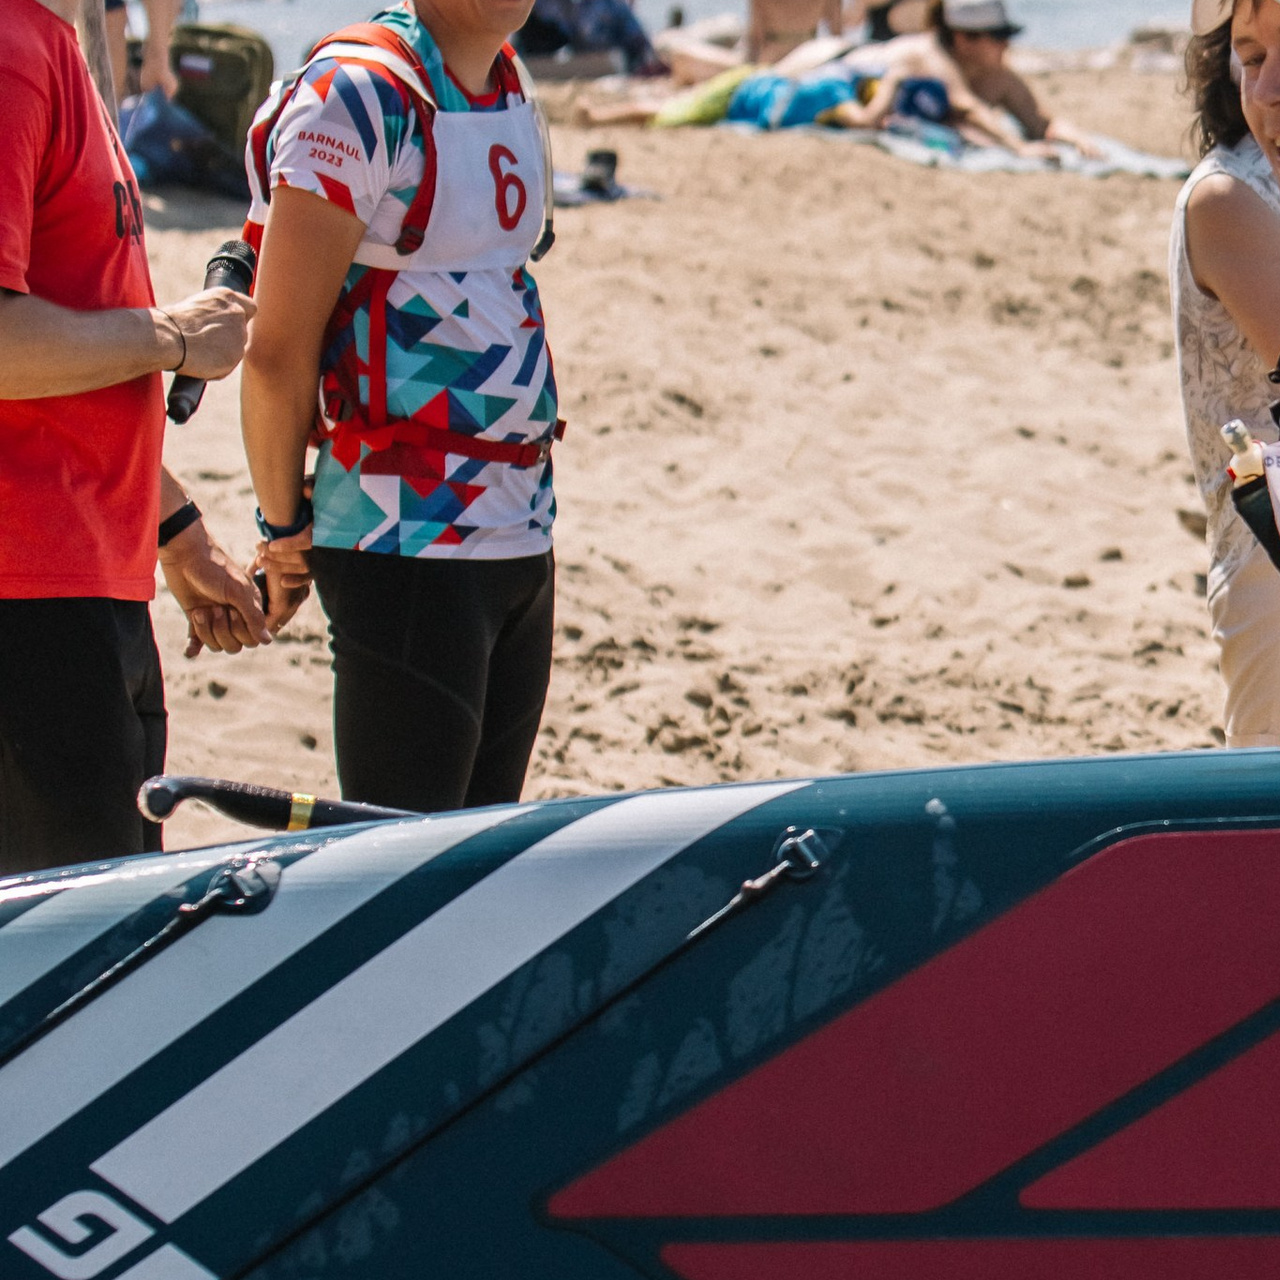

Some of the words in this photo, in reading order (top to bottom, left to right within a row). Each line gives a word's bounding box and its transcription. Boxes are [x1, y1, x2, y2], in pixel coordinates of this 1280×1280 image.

[297, 130, 361, 162] BARNAUL
[308, 147, 343, 168] 2023
[488, 144, 527, 231] 6
